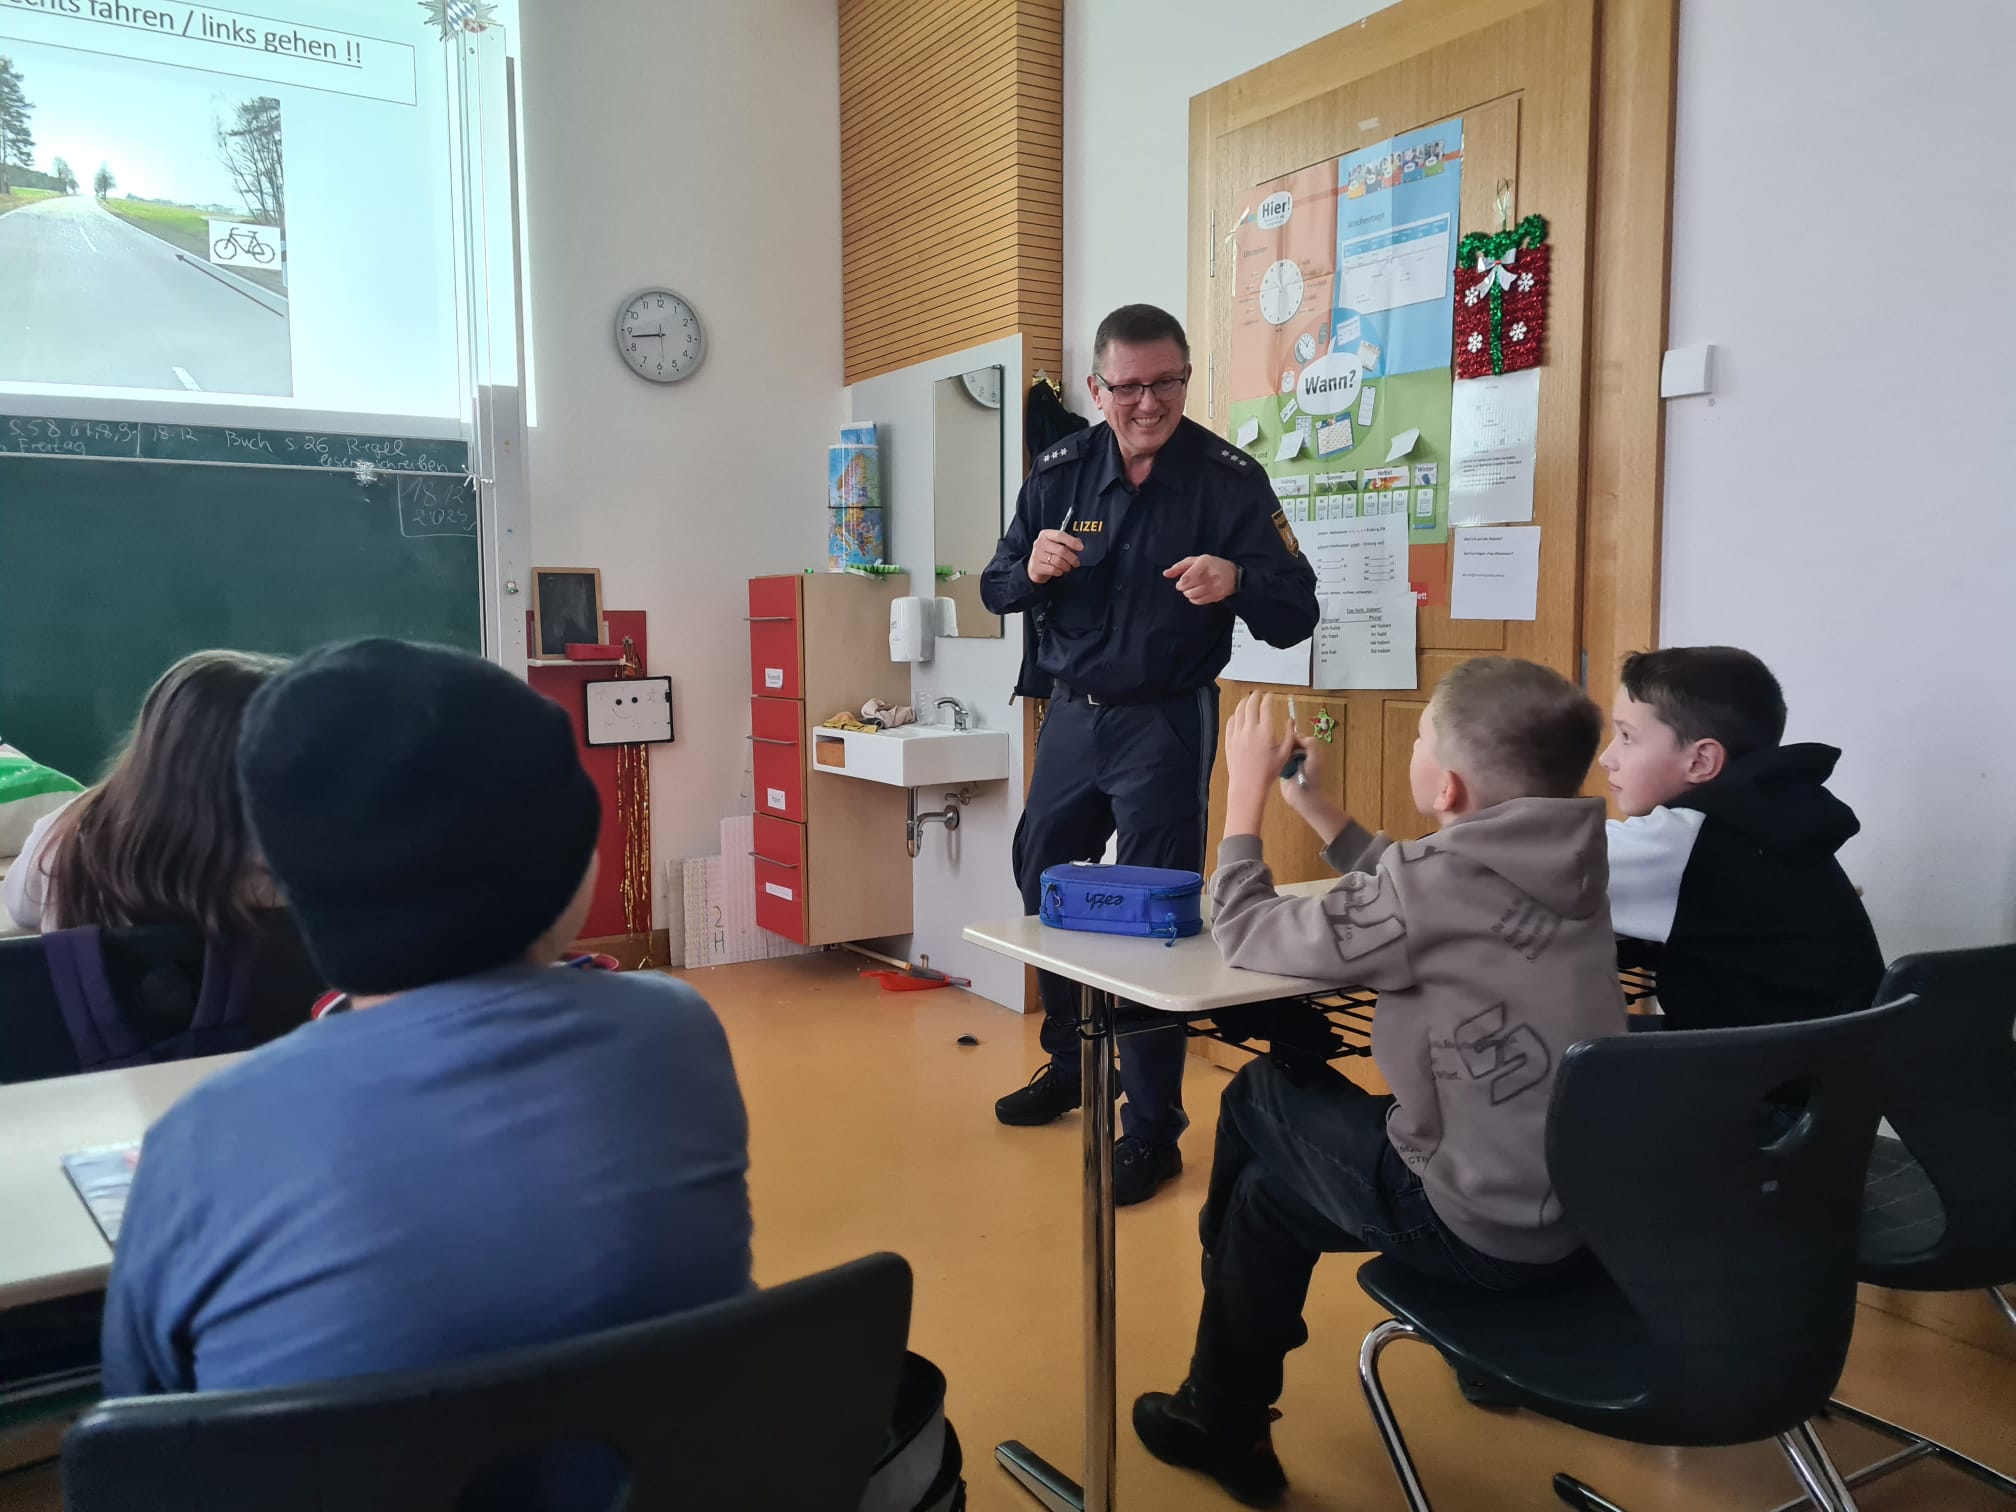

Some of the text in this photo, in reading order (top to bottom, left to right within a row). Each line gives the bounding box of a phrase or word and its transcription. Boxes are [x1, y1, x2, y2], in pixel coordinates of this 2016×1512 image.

[88, 0, 175, 31] fahren
[202, 13, 257, 44] links
[263, 30, 337, 59] gehen
[347, 40, 361, 63] !!
[1262, 196, 1291, 218] Hier!
[1304, 369, 1357, 396] Wann?
[18, 438, 86, 456] Freitag
[225, 430, 273, 453] Buch
[303, 436, 329, 454] 26
[347, 438, 407, 459] Regel
[1073, 520, 1103, 532] LIZEI
[713, 905, 725, 928] 2
[714, 930, 726, 953] H
